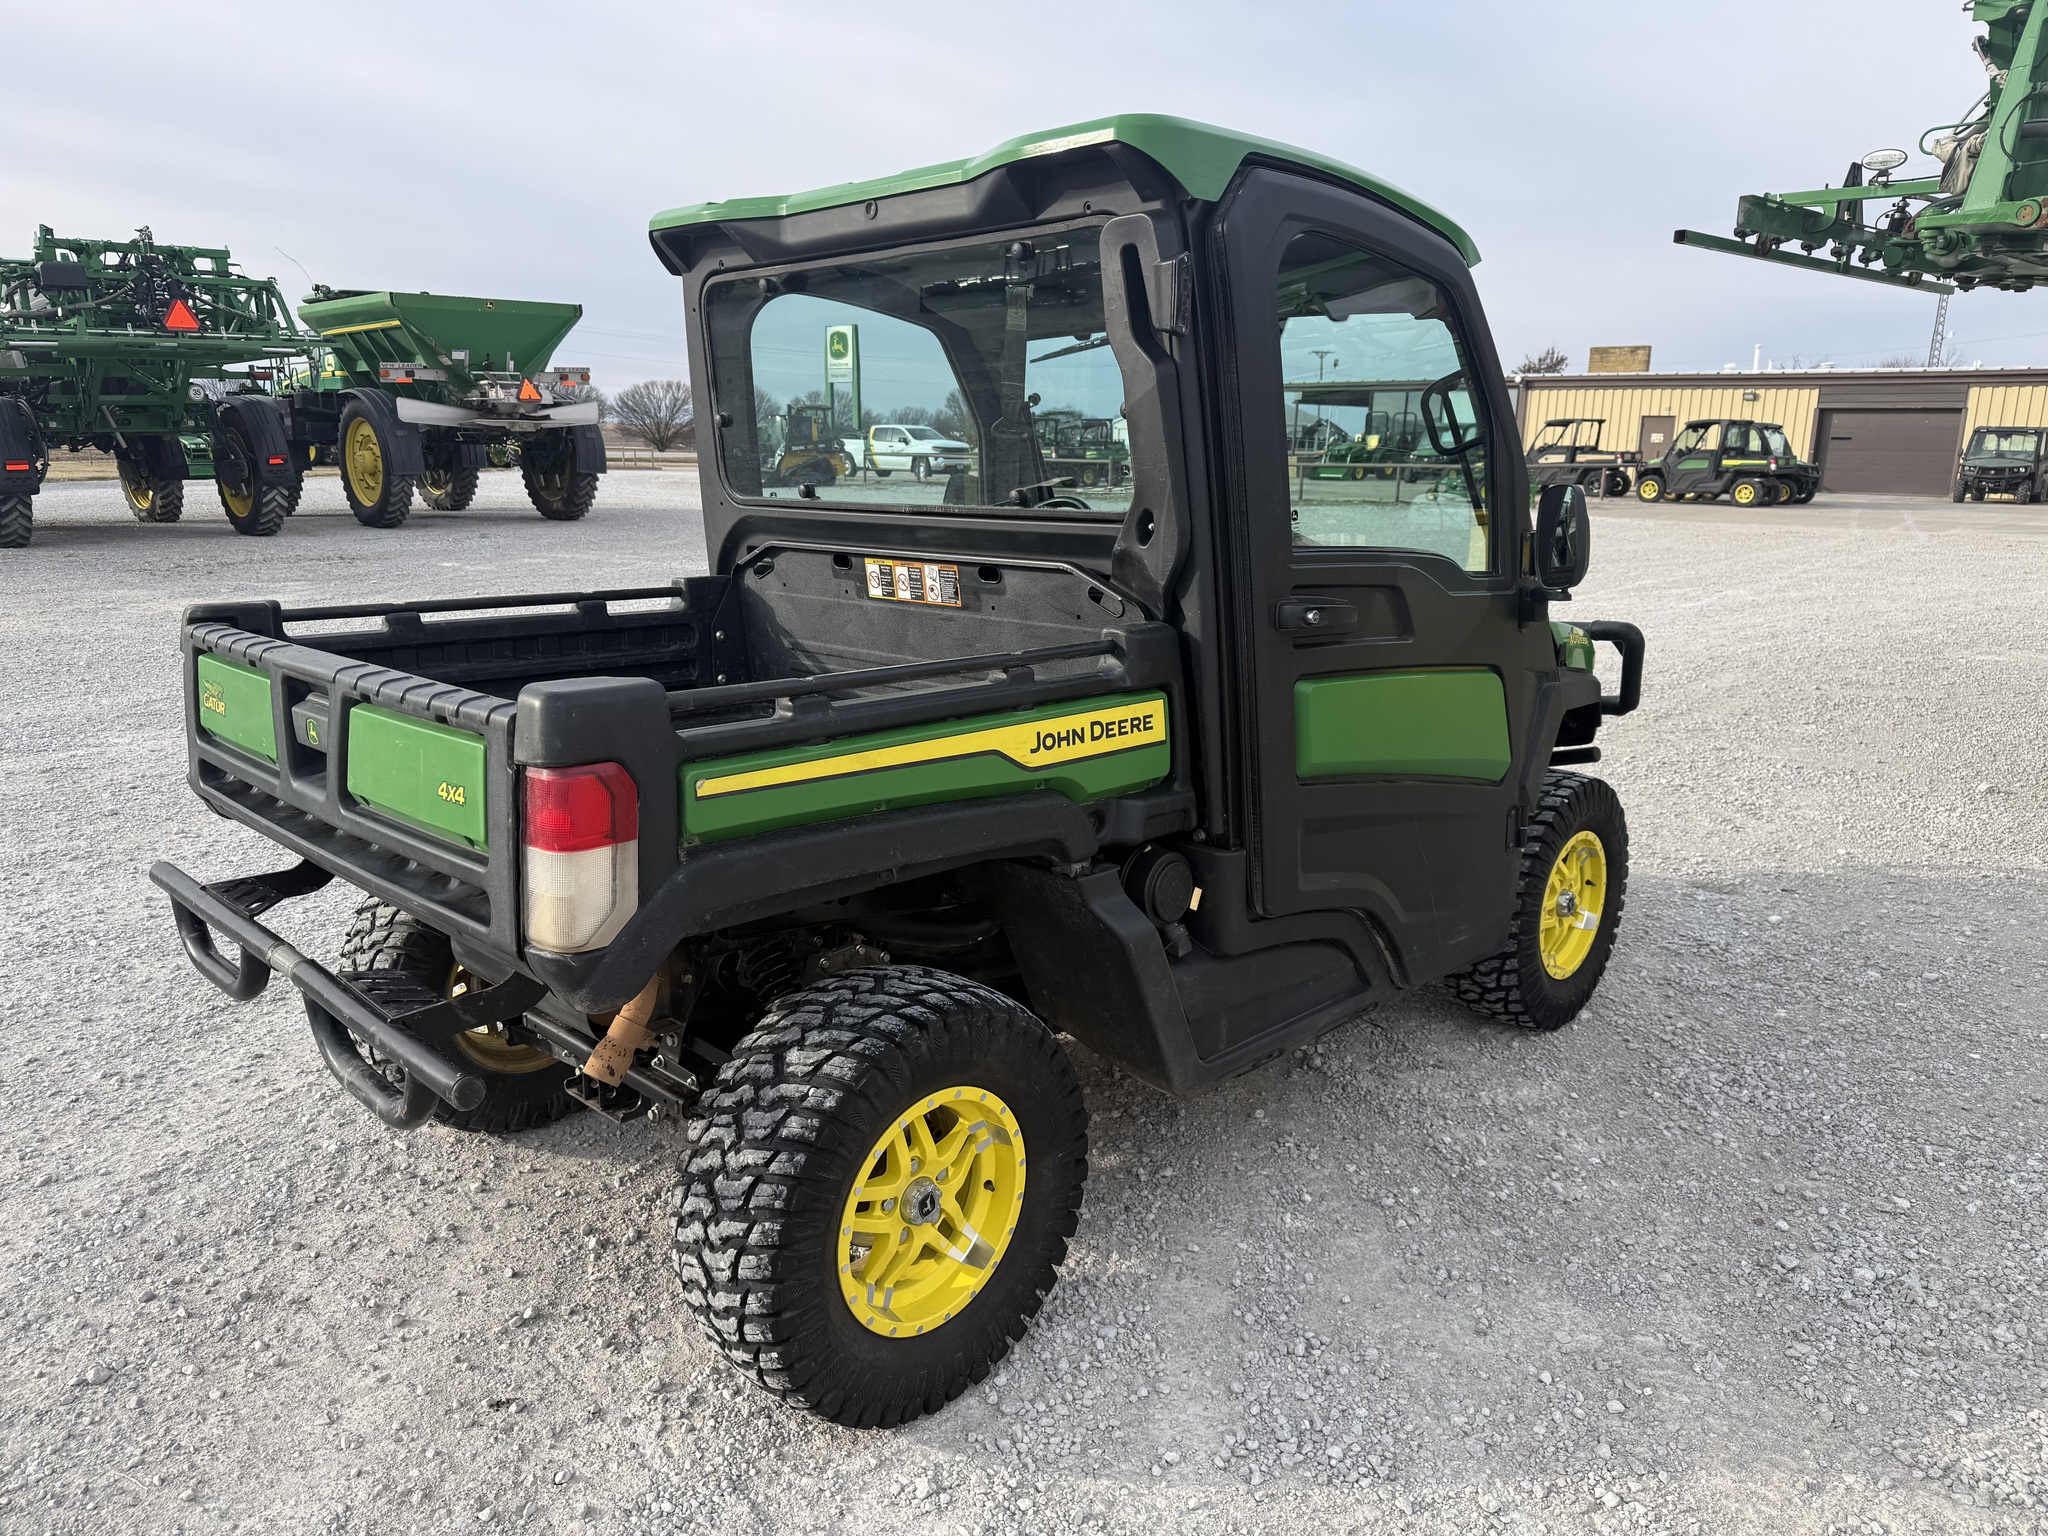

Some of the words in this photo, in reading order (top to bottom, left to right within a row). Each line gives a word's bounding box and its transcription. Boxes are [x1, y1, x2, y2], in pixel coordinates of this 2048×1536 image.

[192, 388, 202, 396] 35
[203, 691, 226, 716] GATOR
[1030, 726, 1085, 754] JOHN
[1090, 713, 1154, 742] DEERE
